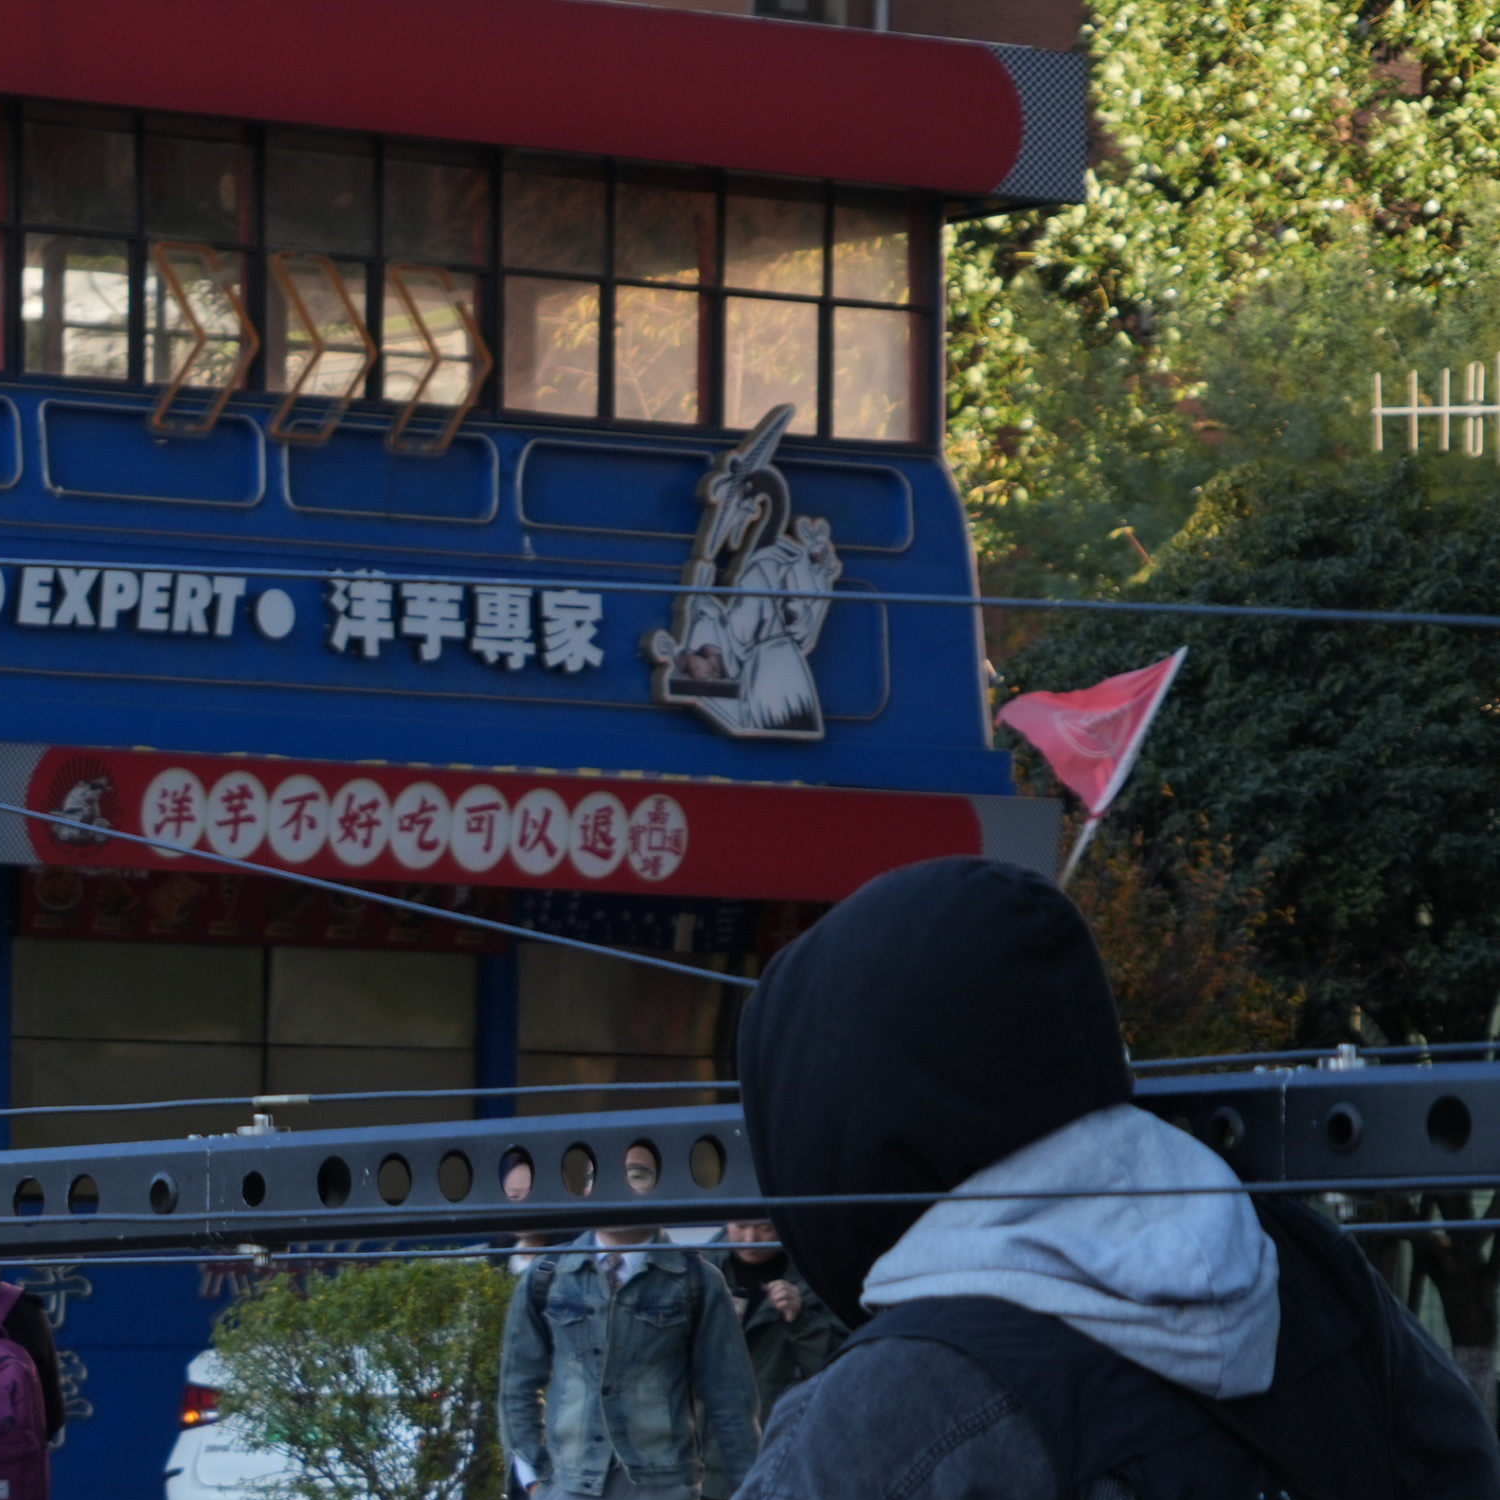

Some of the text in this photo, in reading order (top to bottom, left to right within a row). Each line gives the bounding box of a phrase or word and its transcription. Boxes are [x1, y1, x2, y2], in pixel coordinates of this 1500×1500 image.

[16, 565, 247, 638] EXPERT
[155, 784, 619, 860] 洋芋不好吃可以退
